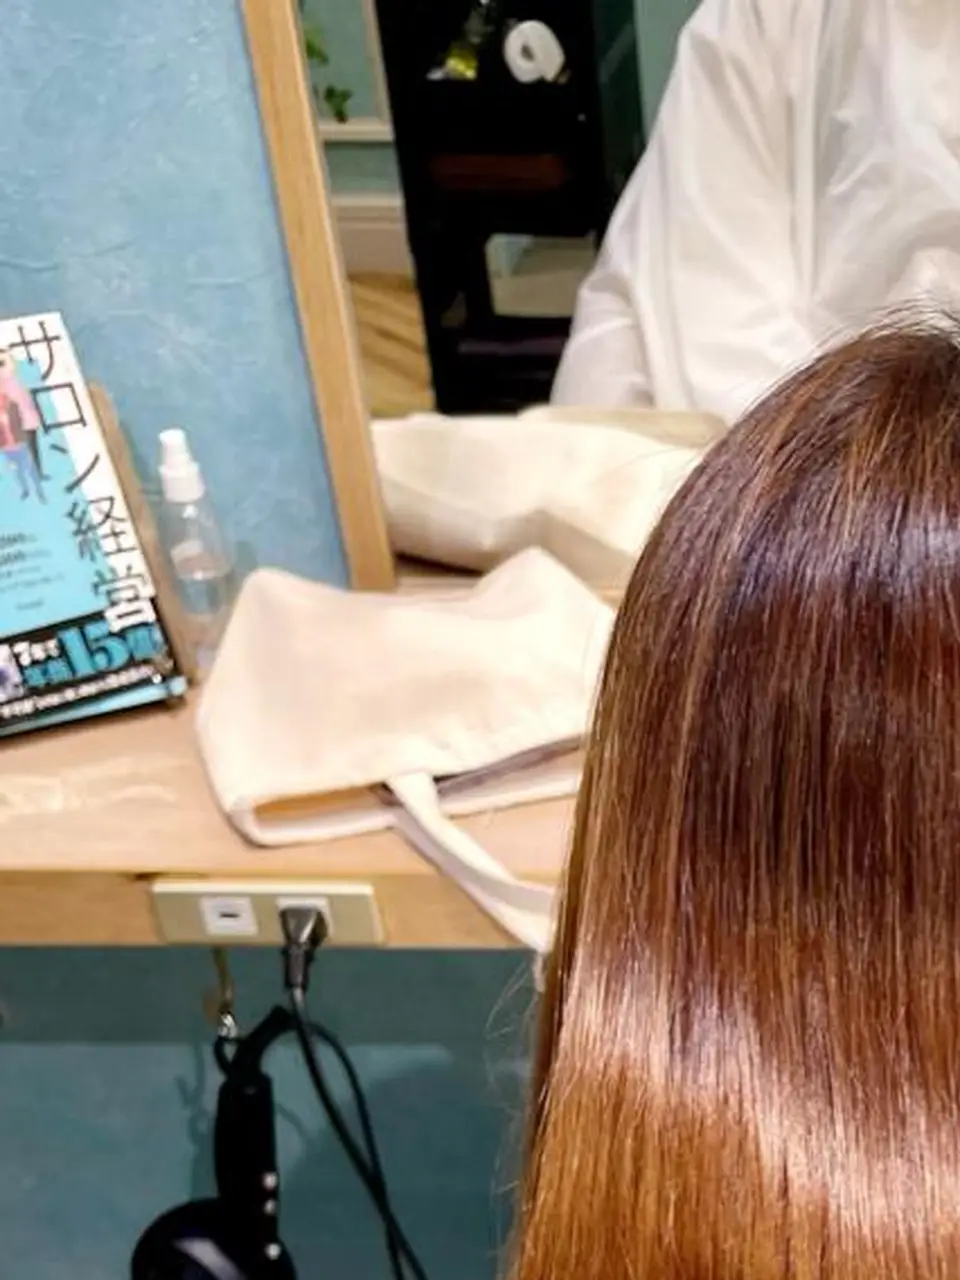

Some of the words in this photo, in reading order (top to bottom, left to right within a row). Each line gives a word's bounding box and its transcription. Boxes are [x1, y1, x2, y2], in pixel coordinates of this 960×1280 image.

[8, 319, 156, 632] サロン経営
